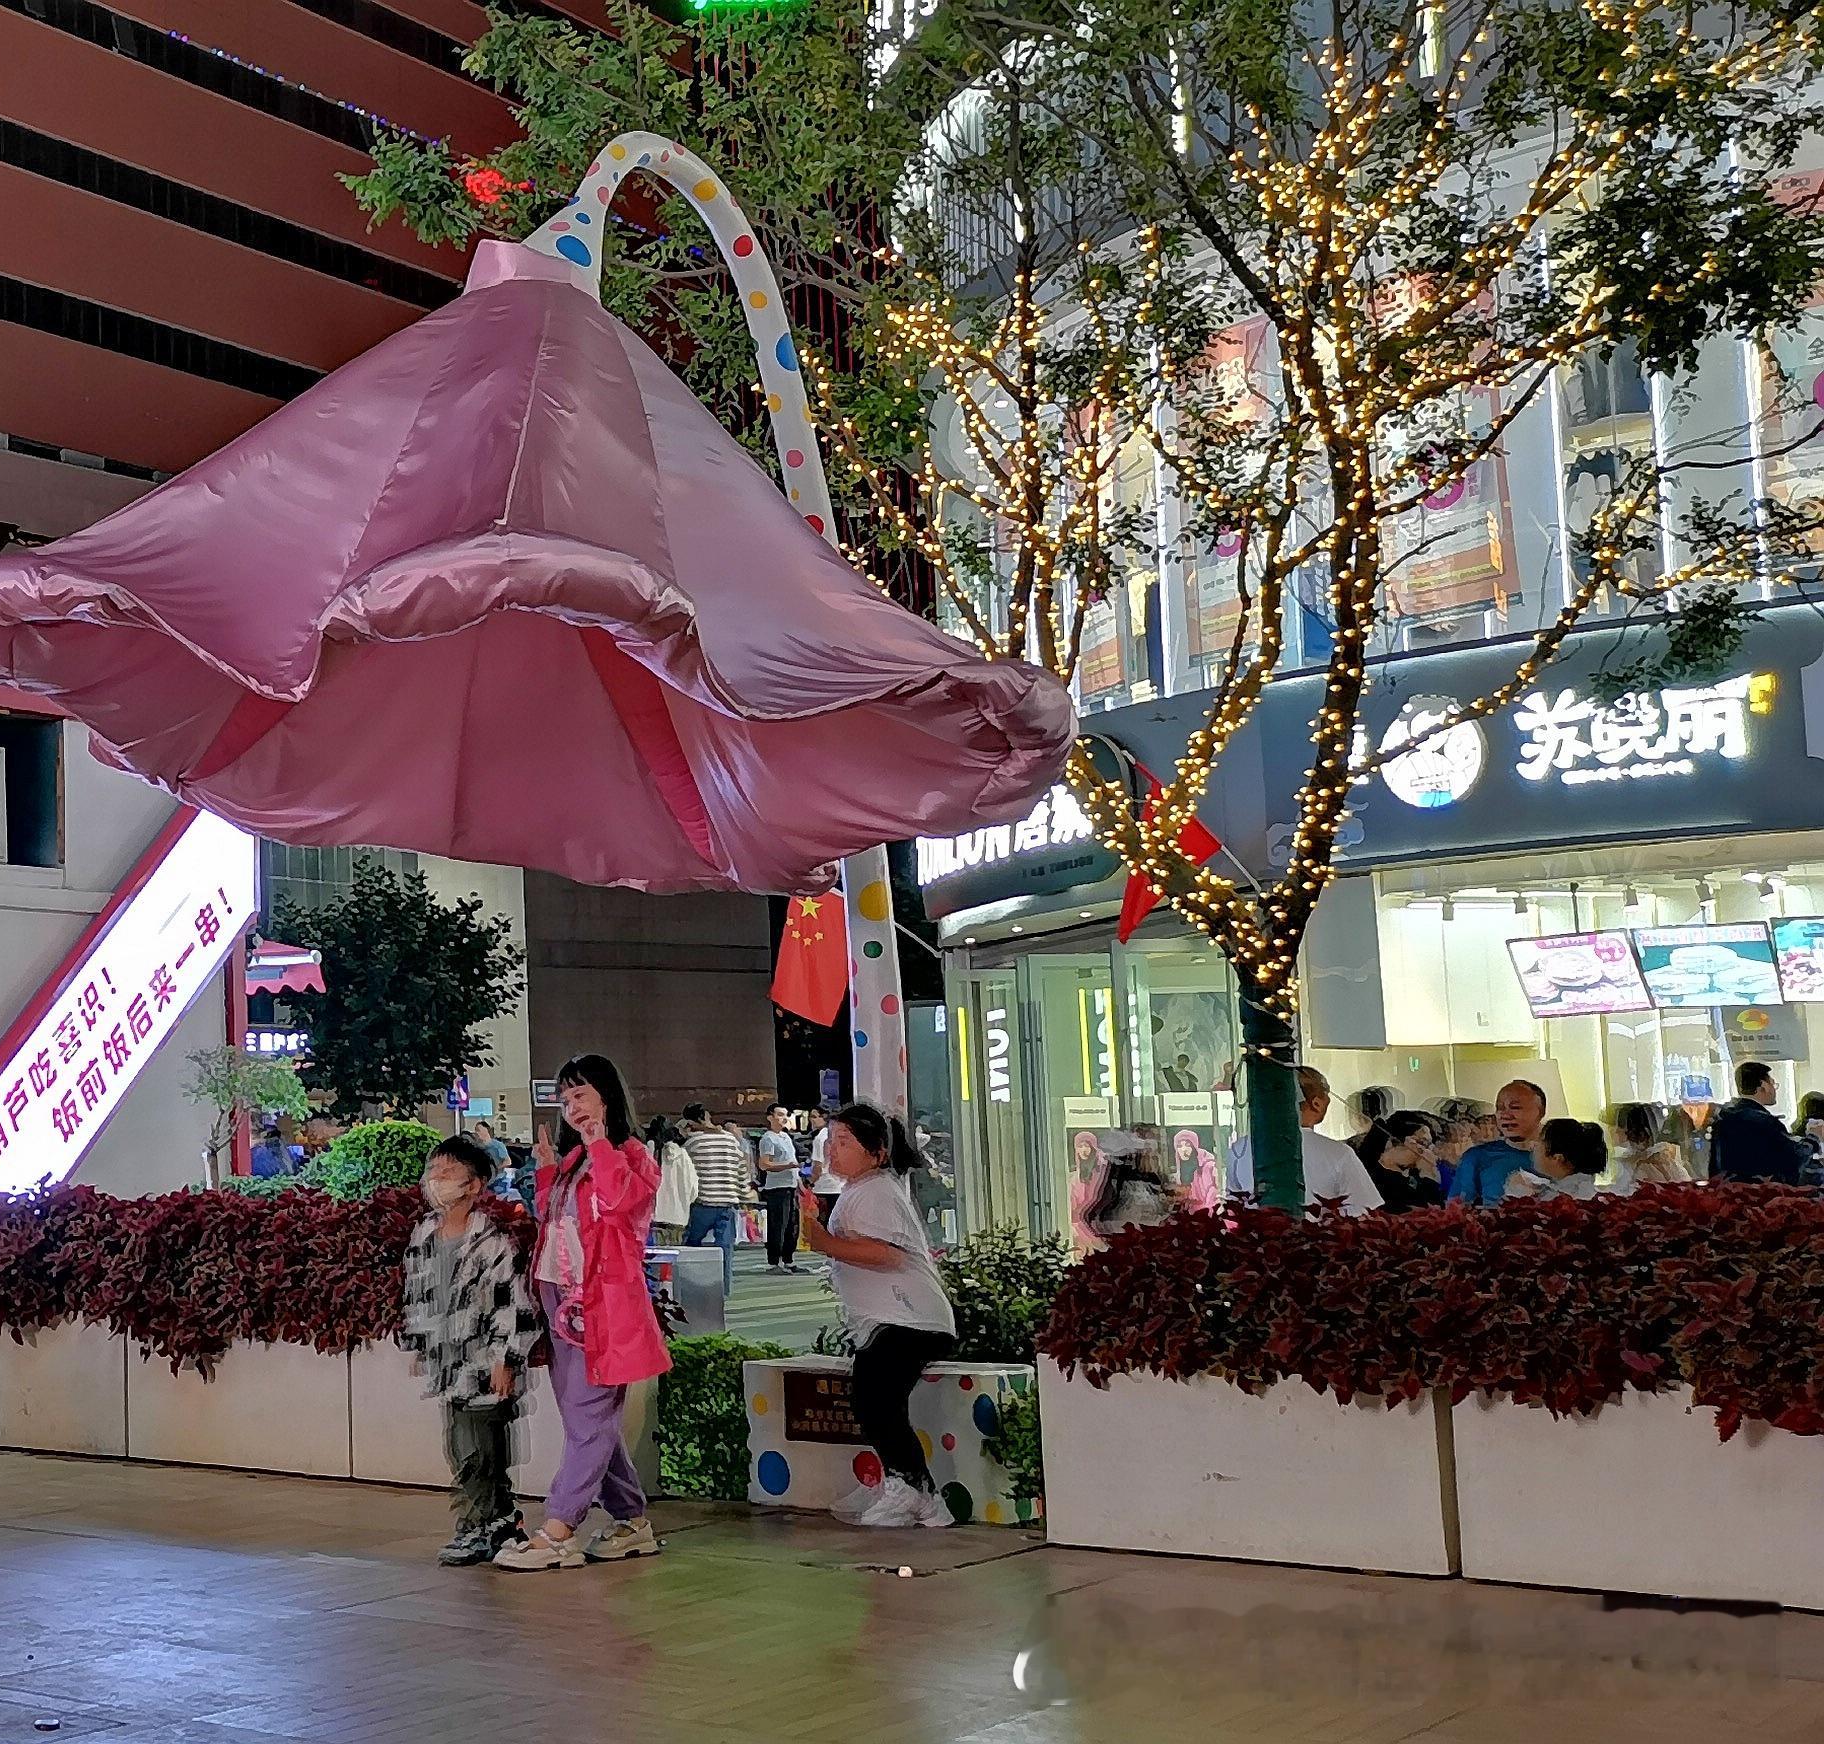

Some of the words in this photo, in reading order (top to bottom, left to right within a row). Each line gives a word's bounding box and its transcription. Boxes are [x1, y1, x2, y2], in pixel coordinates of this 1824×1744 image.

[52, 887, 233, 1143] 饭前饭后来一串！
